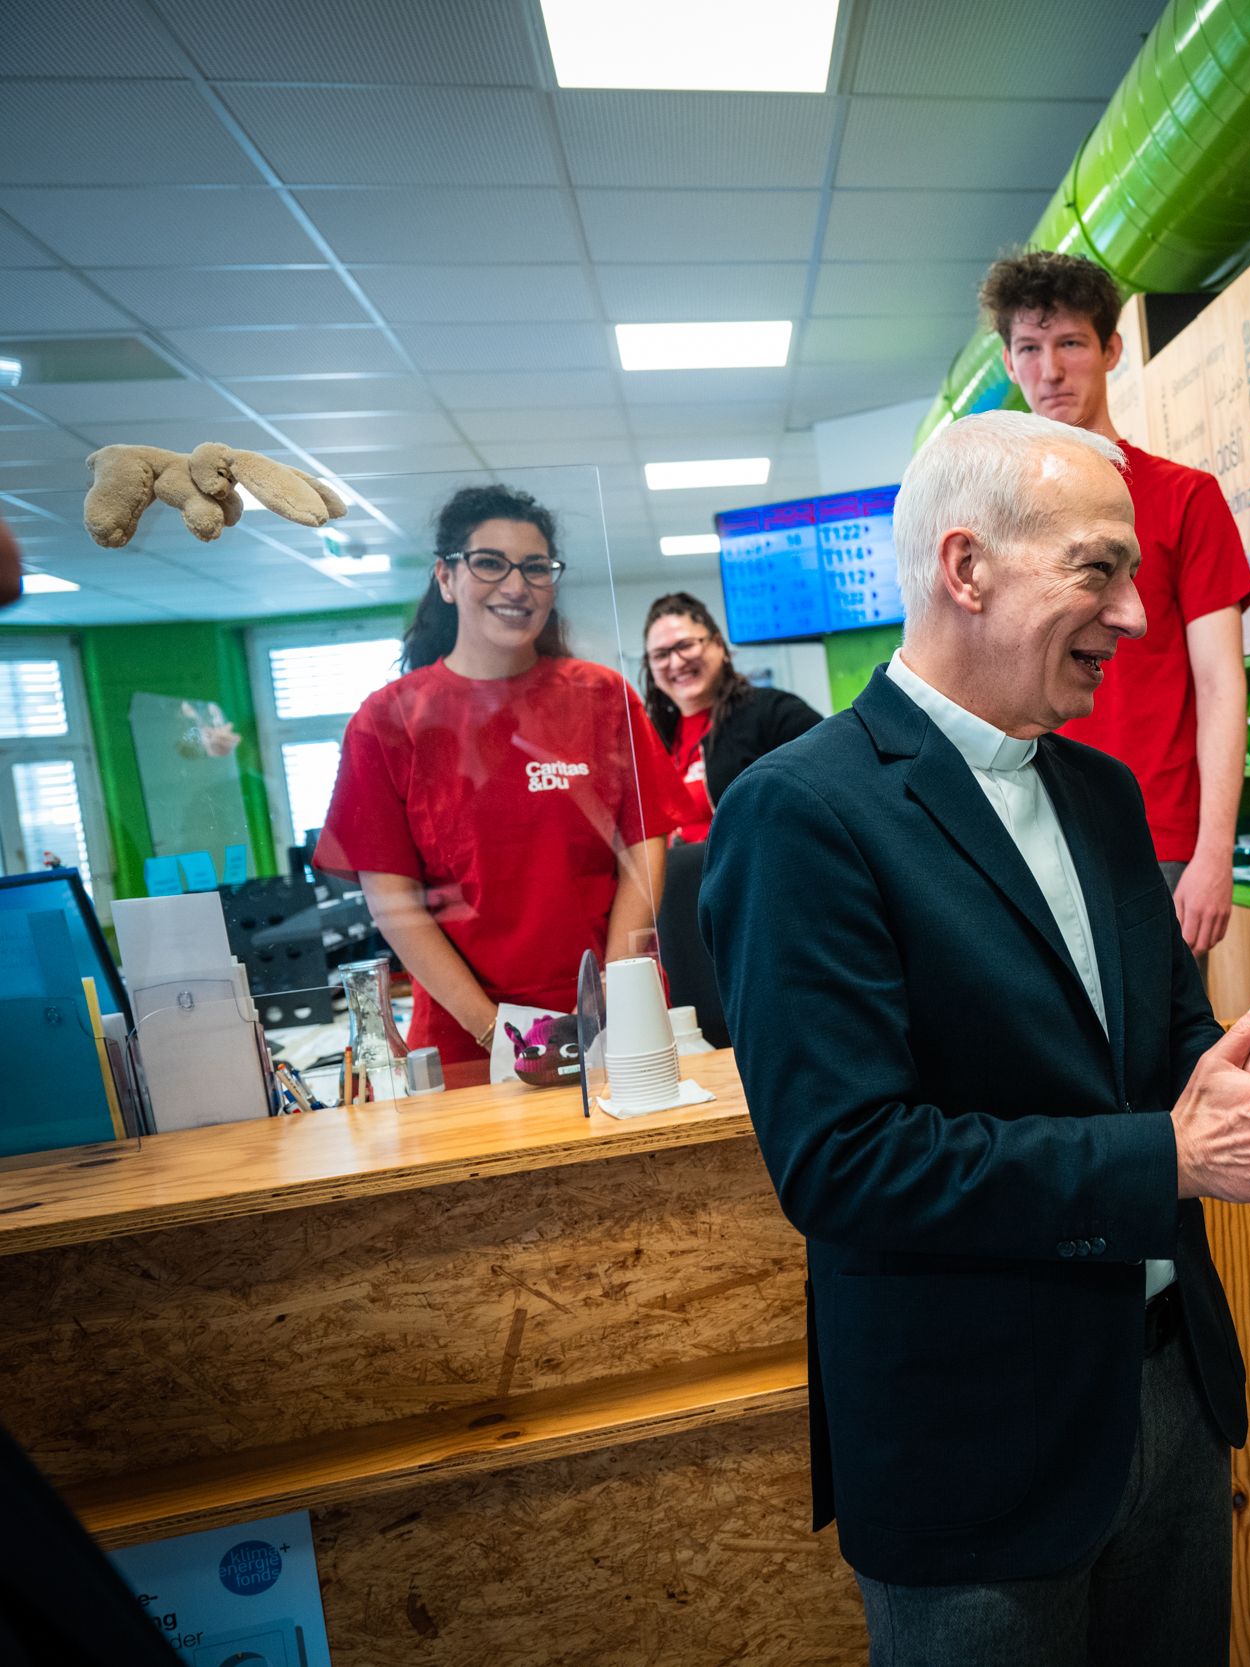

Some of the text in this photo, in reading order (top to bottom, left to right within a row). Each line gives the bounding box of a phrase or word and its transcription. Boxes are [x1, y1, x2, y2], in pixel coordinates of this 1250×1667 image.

[525, 760, 590, 777] Caritas
[527, 776, 570, 792] &Du
[219, 1553, 280, 1577] energie
[236, 1567, 281, 1588] fonds
